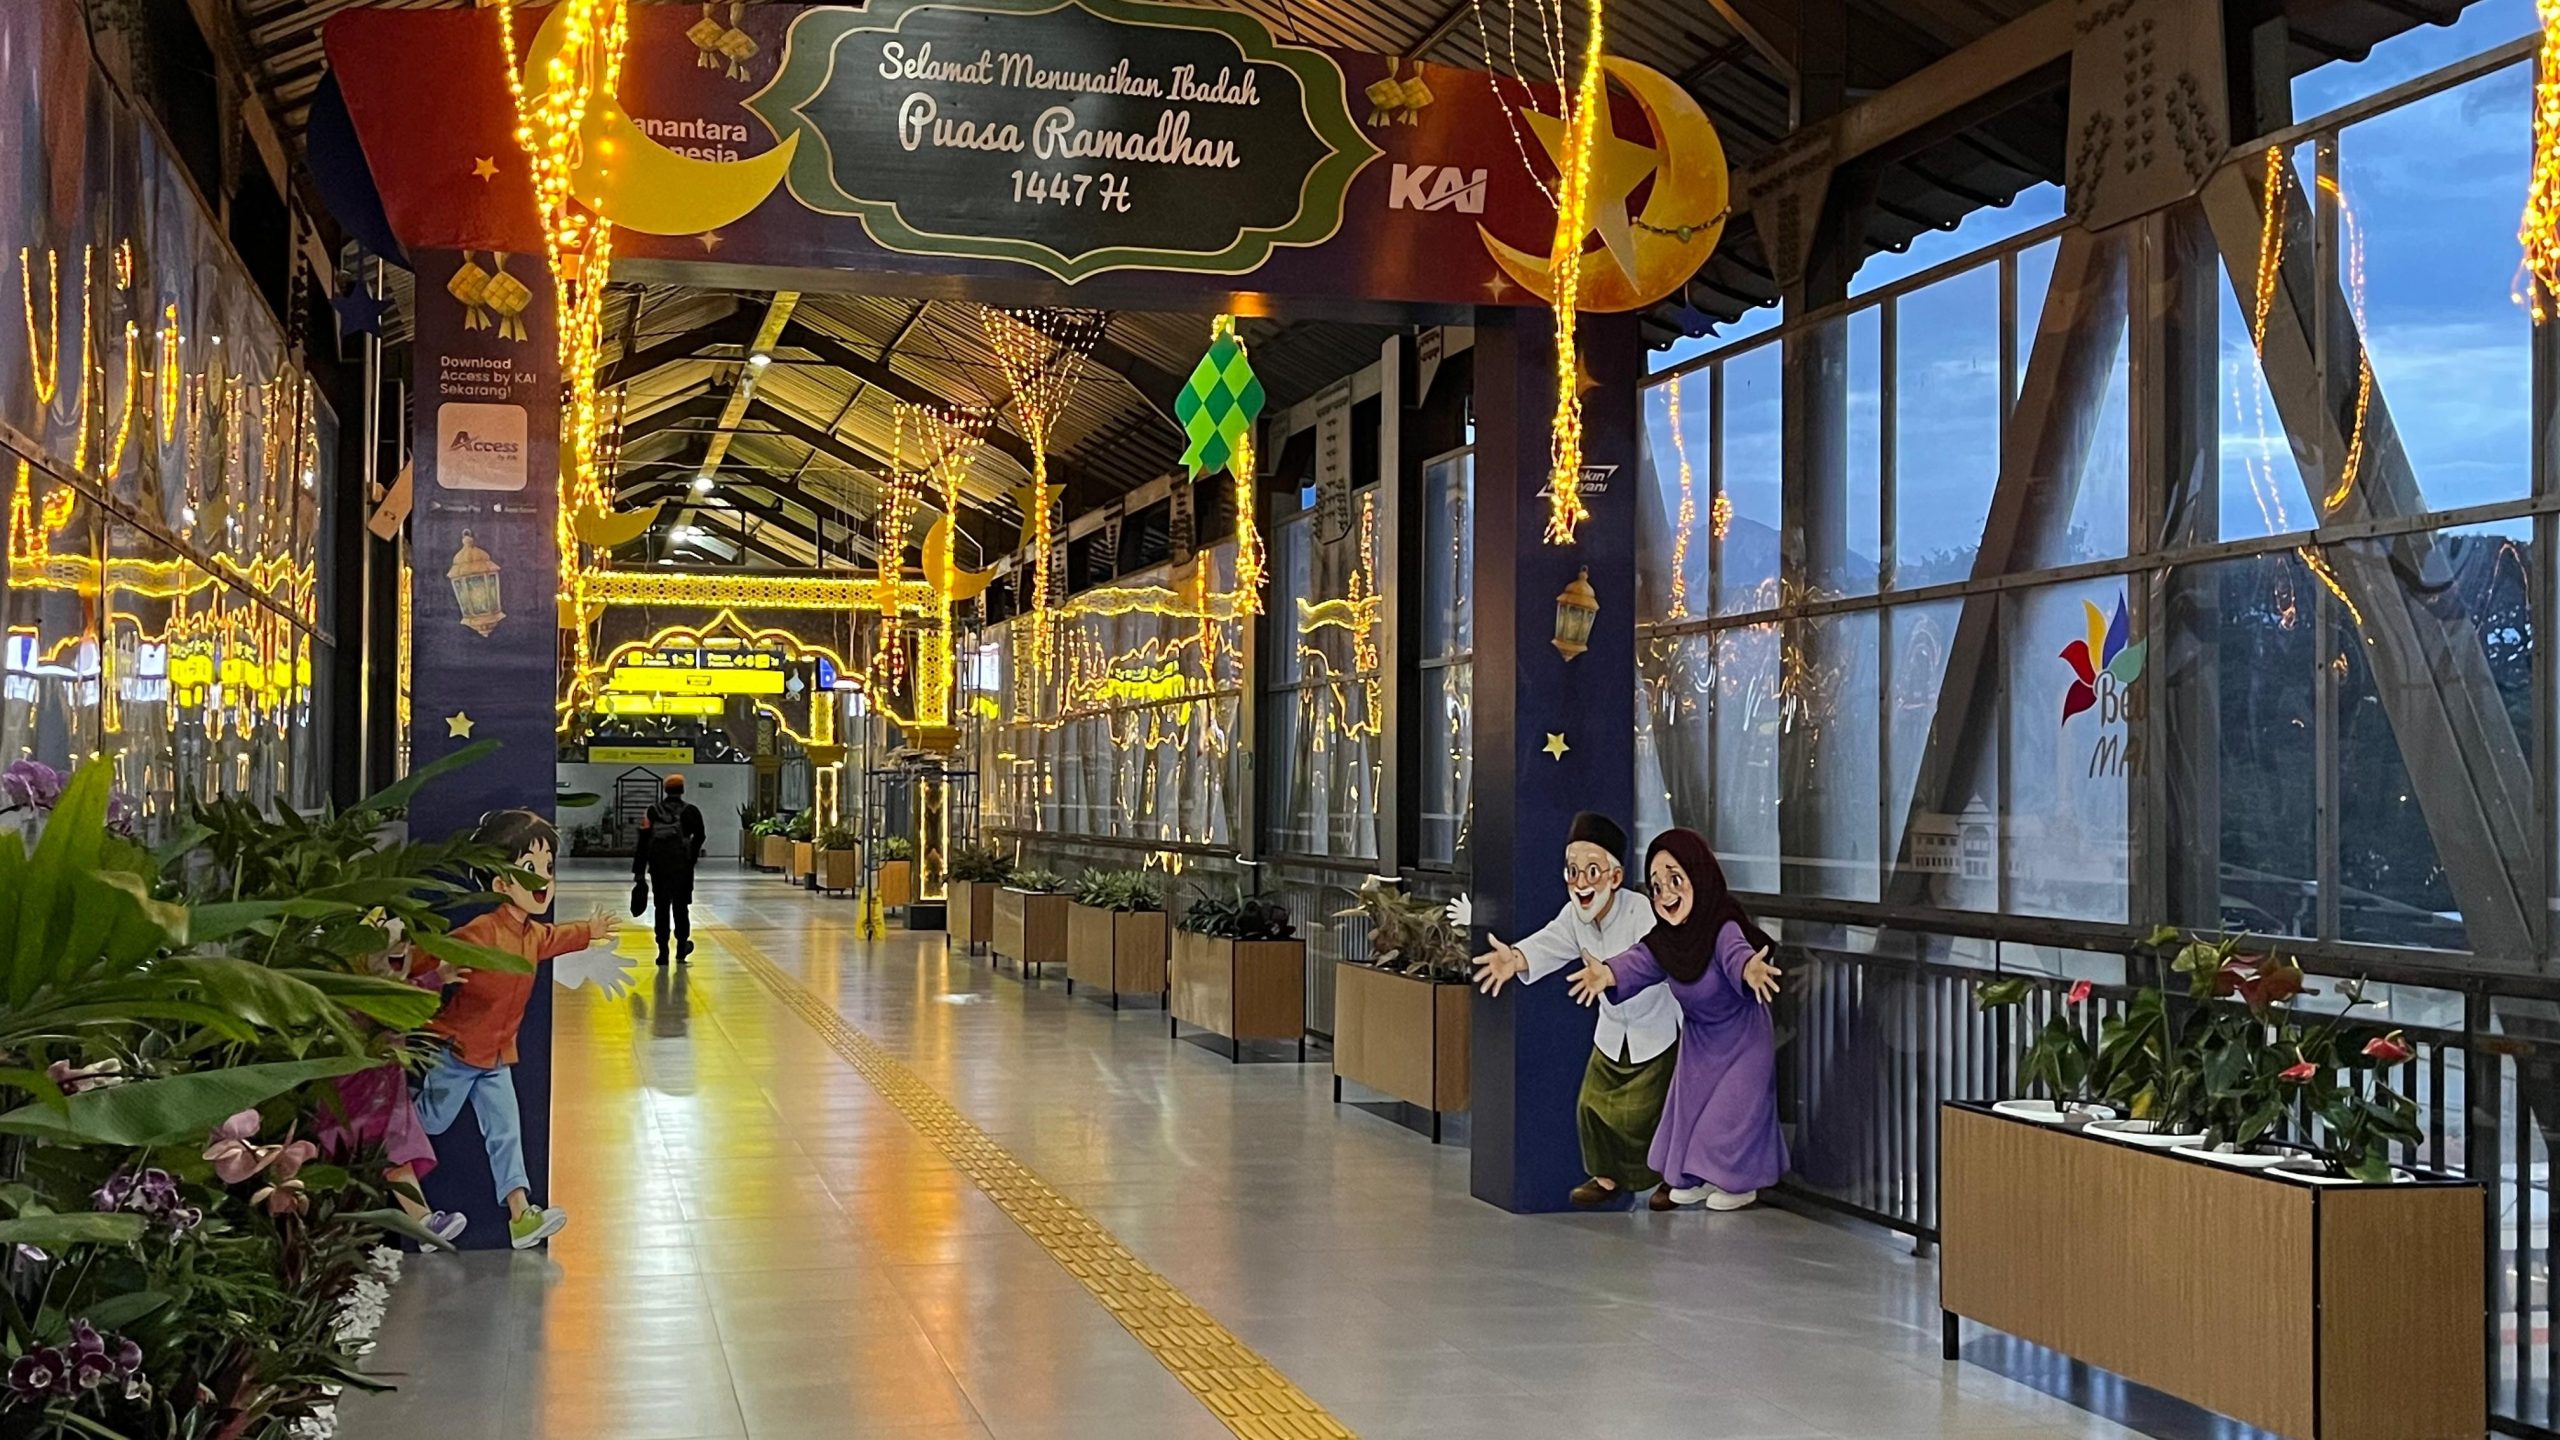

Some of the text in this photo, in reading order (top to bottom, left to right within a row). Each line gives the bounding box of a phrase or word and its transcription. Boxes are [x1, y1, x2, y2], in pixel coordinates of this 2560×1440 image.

[879, 41, 1260, 106] Selamat Menunaikan Ibadah
[632, 117, 748, 142] anantara
[898, 91, 1241, 169] Puasa Ramadhan
[668, 143, 739, 163] nesia
[1011, 170, 1132, 213] 1447 H
[1389, 163, 1488, 214] KAI
[441, 355, 512, 370] Download
[440, 370, 537, 386] Access by KAI
[440, 383, 512, 400] Sekarang!
[450, 431, 519, 453] Access
